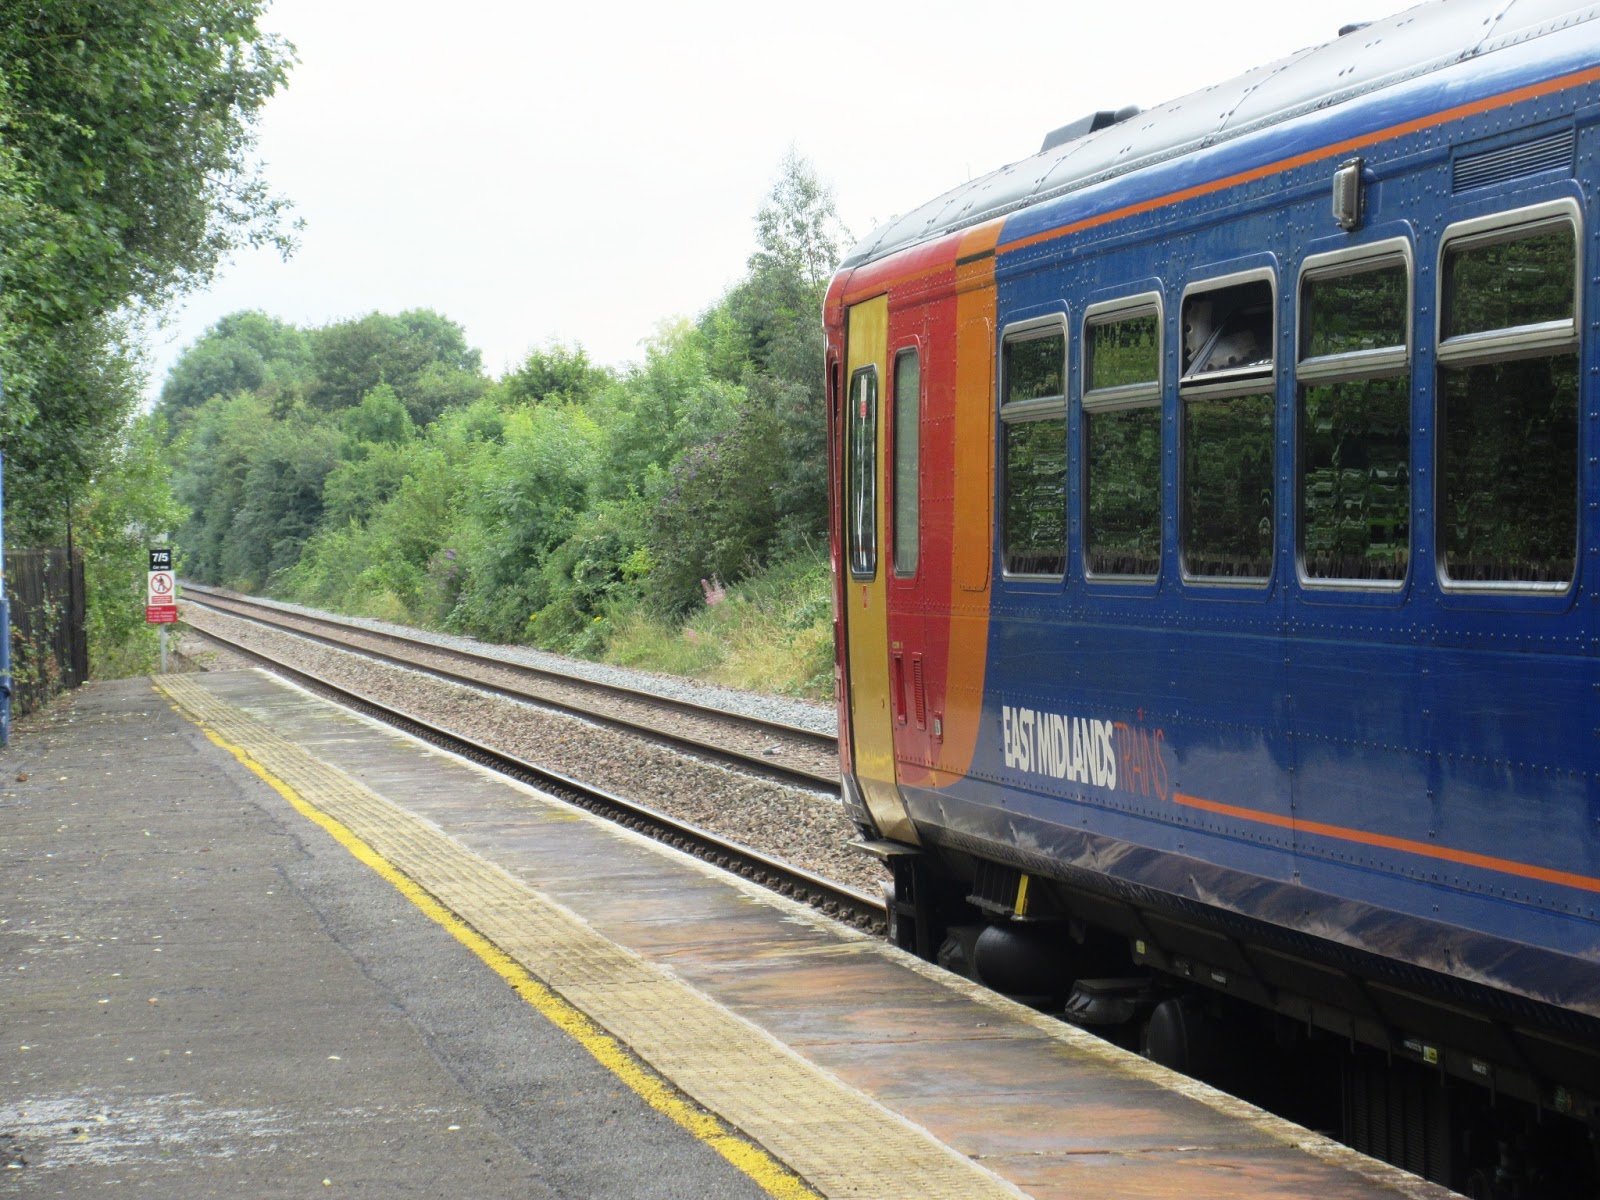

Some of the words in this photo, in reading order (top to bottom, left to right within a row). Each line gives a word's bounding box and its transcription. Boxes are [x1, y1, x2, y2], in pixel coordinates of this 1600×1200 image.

[152, 553, 169, 562] 7/5
[1002, 705, 1035, 772] EAST
[1036, 711, 1117, 790] MIDLANDS
[1114, 706, 1168, 801] TRAINS
